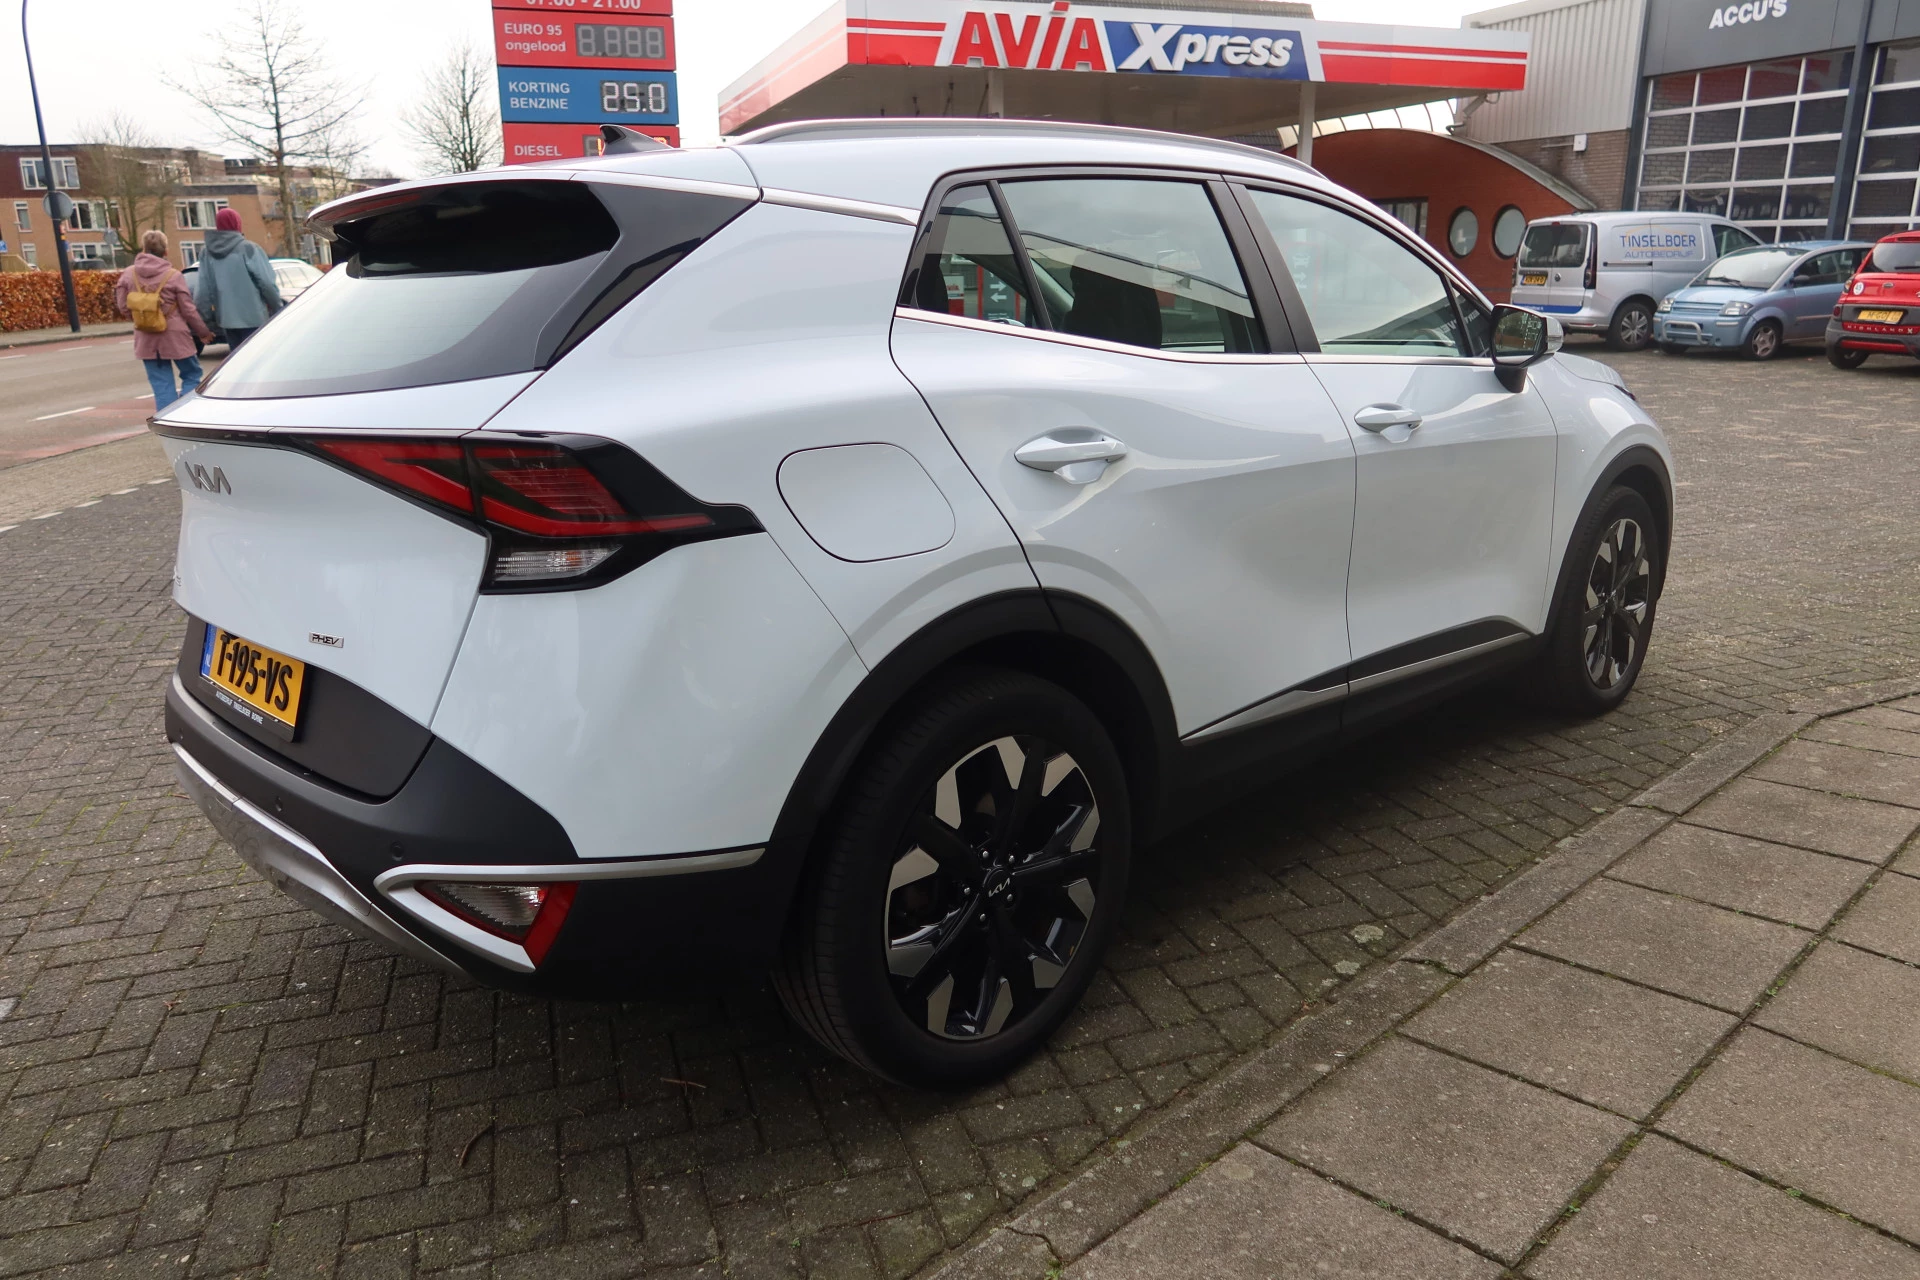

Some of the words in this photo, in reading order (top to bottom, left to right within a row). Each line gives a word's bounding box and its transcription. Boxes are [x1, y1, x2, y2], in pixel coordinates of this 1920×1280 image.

[1708, 0, 1788, 29] ACCU'S
[504, 23, 543, 35] EURO
[546, 25, 562, 36] 95
[505, 41, 566, 54] ongelood
[1117, 23, 1294, 71] Xpress
[508, 82, 570, 94] KORTING
[510, 97, 568, 109] BENZINE
[603, 82, 665, 112] 25.0
[514, 145, 562, 156] DIESEL
[1620, 234, 1697, 247] TINSELBOER
[312, 633, 339, 645] PHEV
[217, 633, 293, 711] T-195-VS
